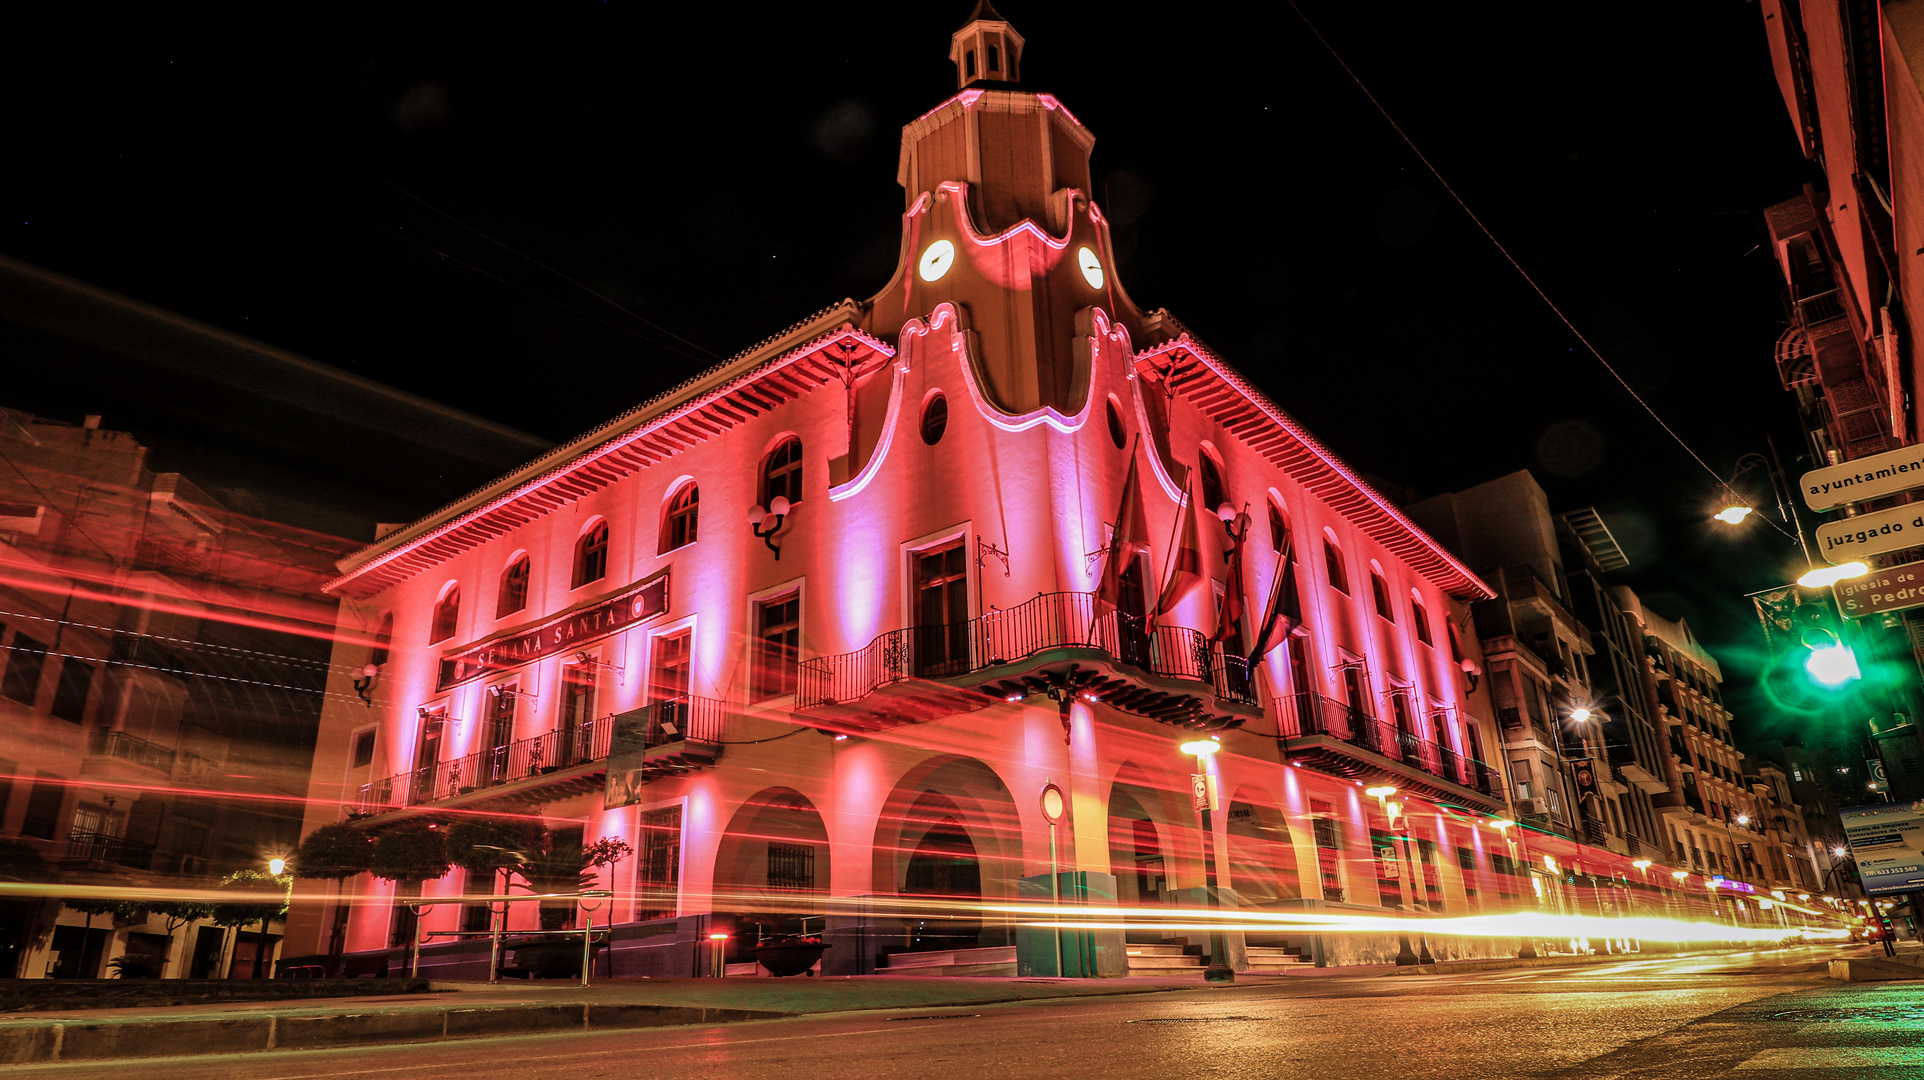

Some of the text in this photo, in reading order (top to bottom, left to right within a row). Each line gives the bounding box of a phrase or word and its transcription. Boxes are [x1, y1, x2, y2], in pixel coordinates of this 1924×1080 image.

[1810, 458, 1924, 495] ayuntamien
[1826, 522, 1903, 549] juzgado
[1840, 572, 1915, 597] iglesia de
[1845, 599, 1864, 611] S.
[477, 609, 616, 669] SEMANA SANTA
[1848, 829, 1887, 838] Generadores
[1877, 868, 1890, 876] 633
[1904, 865, 1918, 873] 569
